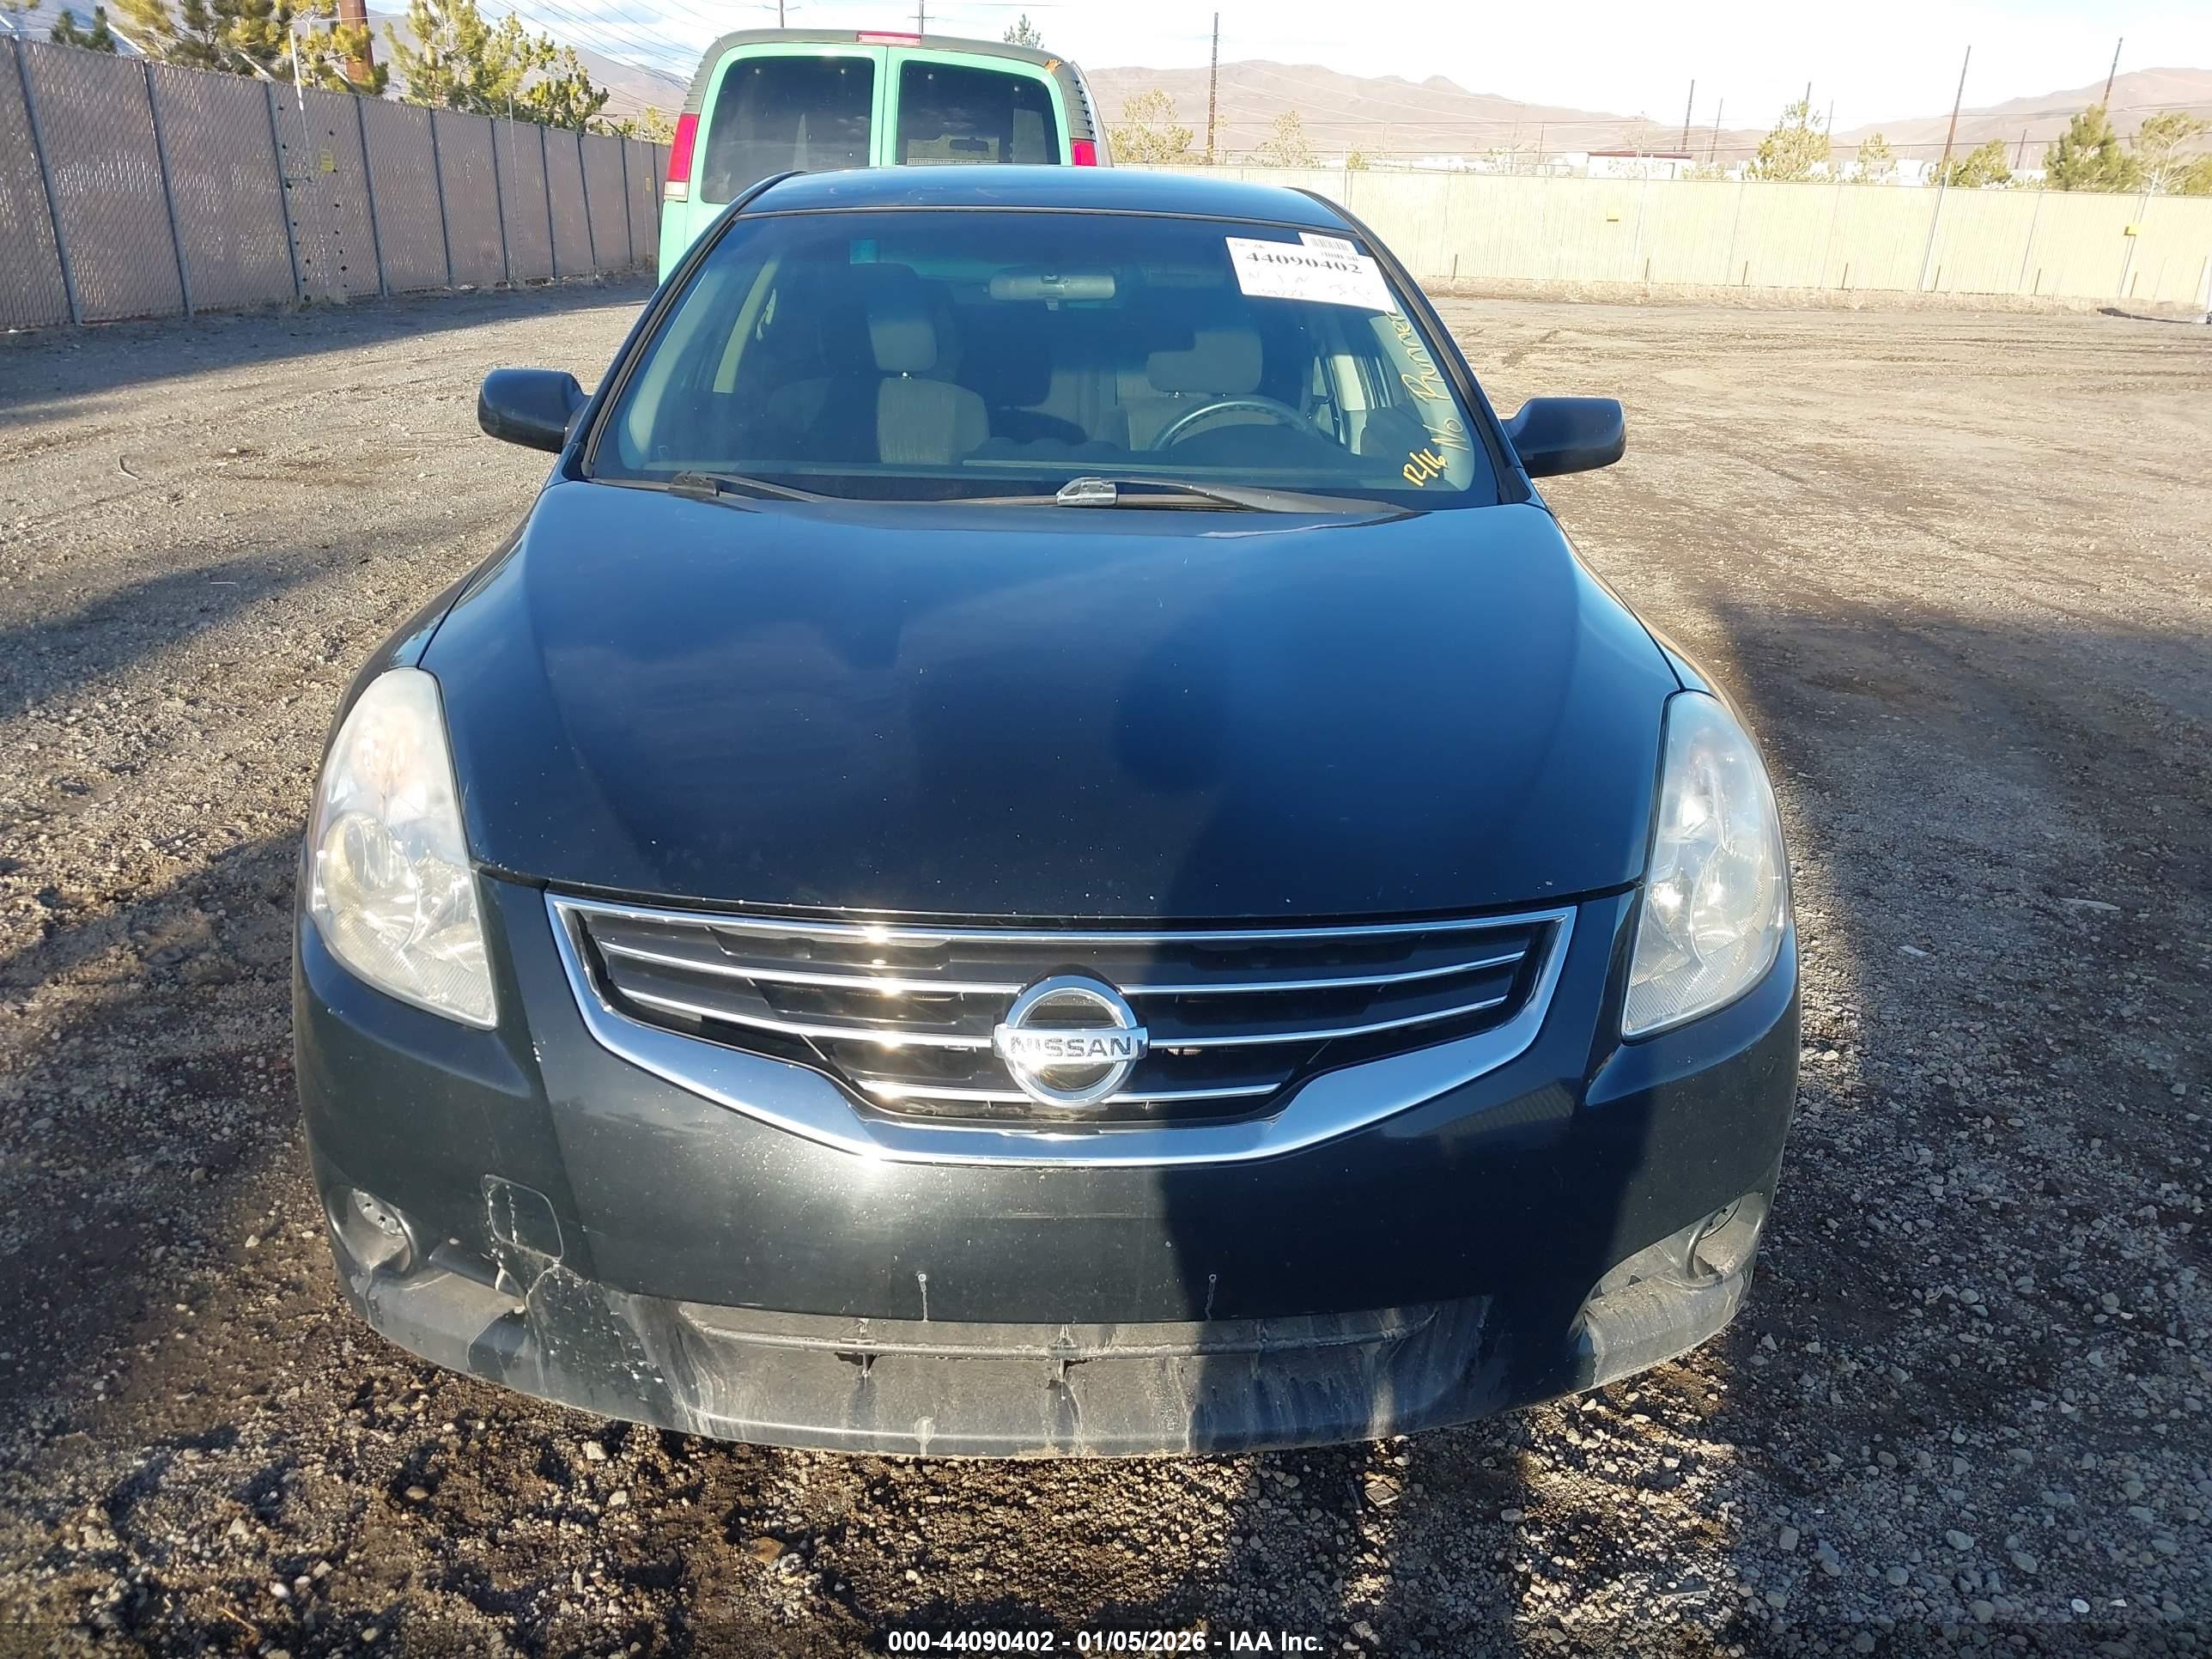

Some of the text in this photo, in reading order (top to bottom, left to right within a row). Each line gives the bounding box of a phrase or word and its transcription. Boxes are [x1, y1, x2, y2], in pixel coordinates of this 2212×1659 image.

[1245, 252, 1364, 275] 44090402
[1402, 447, 1449, 487] 12/16
[1010, 1036, 1132, 1057] NISSAN
